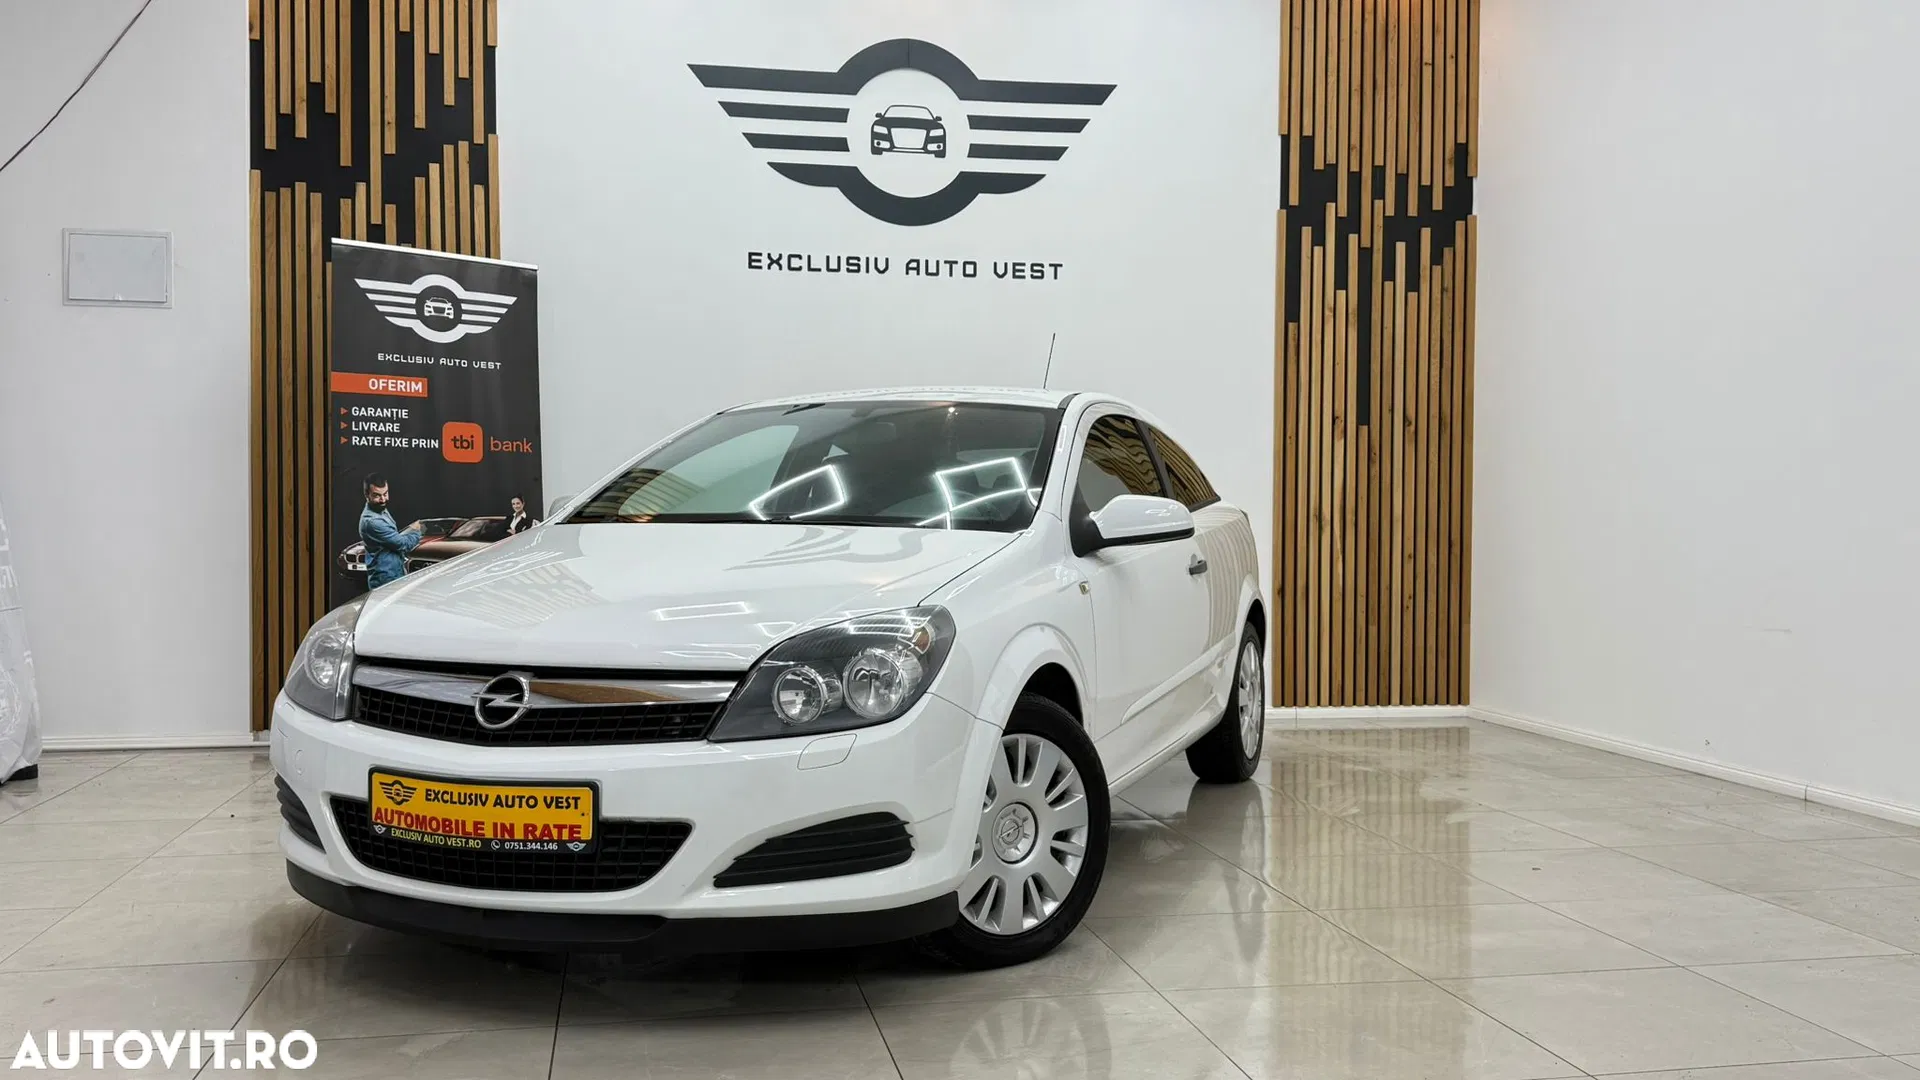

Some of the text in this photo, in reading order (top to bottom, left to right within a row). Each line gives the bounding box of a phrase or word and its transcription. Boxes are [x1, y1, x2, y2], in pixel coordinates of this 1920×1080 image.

[747, 251, 1064, 280] EXCLUSIV AUTO VEST
[377, 352, 502, 370] EXCLUSIV AUTO VEST
[368, 378, 423, 393] OFERIM
[351, 421, 401, 433] LIVRARE
[351, 436, 440, 449] RATE FIXE PRIN
[451, 434, 533, 453] tbi bank
[425, 788, 581, 810] EXCLUSIV AUTO VEST
[374, 807, 583, 840] AUTOMOBILE IN RATE
[391, 828, 482, 849] EXCLUSIV AUTO VEST.RO
[504, 841, 559, 851] 0751.344.146
